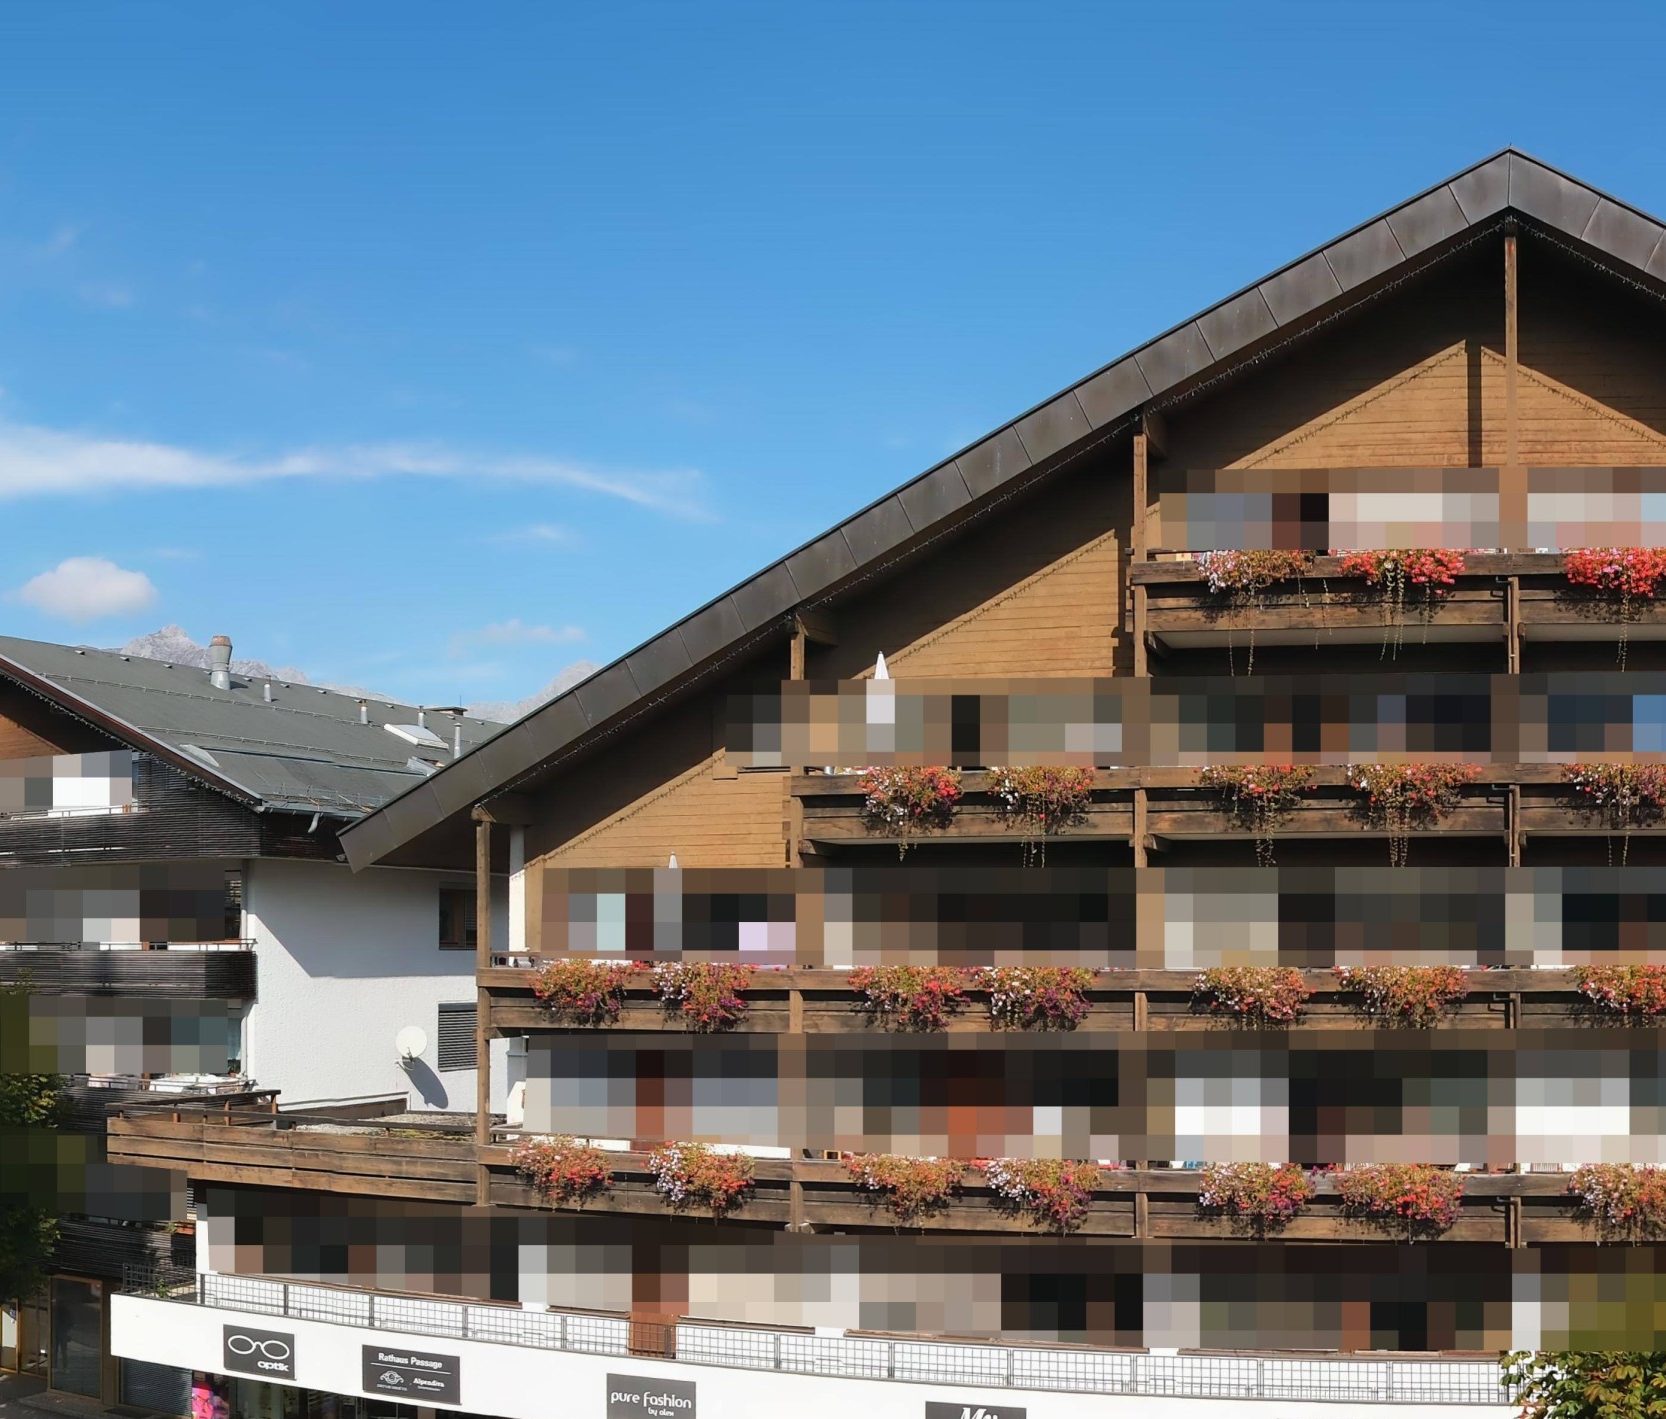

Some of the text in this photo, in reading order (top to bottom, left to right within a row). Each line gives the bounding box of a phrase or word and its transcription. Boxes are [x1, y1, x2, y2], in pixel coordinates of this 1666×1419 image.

[257, 1360, 290, 1372] optik
[378, 1352, 443, 1369] Rathaus Passage
[610, 1391, 692, 1408] pure fashion
[648, 1407, 674, 1417] by alex
